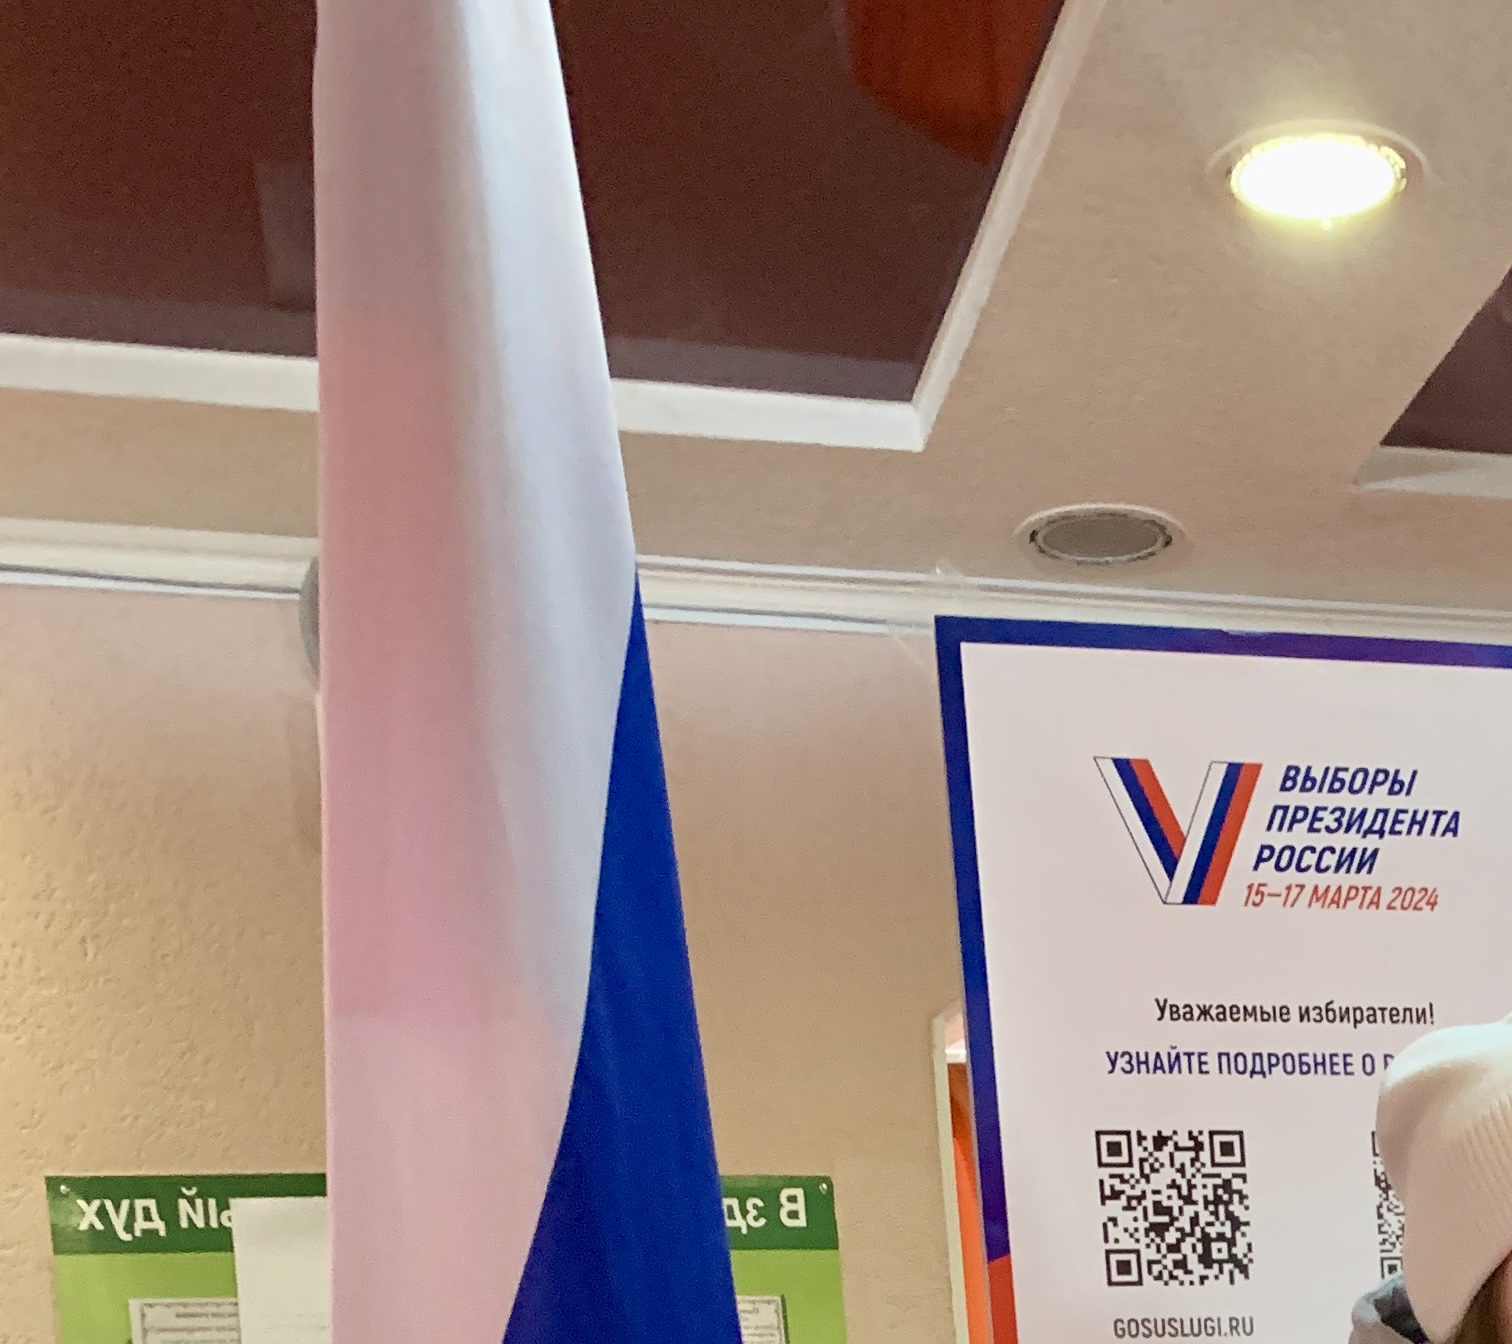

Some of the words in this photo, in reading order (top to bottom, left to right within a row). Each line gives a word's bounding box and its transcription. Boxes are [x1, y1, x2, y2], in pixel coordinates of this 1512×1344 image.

[1279, 765, 1417, 796] ВЫБОРЫ
[1266, 806, 1460, 839] ПРЕЗИДЕНТА
[1253, 845, 1379, 875] РОССИИ
[1308, 885, 1381, 911] МАРТА
[1387, 886, 1438, 912] 2024
[1155, 999, 1291, 1024] Уважаемые
[1299, 1002, 1434, 1029] избиратели!
[1106, 1047, 1209, 1075] УЗНАЙТЕ
[1218, 1052, 1354, 1079] ПОДРОБНЕЕ
[1362, 1054, 1375, 1076] О
[1113, 1316, 1254, 1339] GOSUSLUGI.RU
